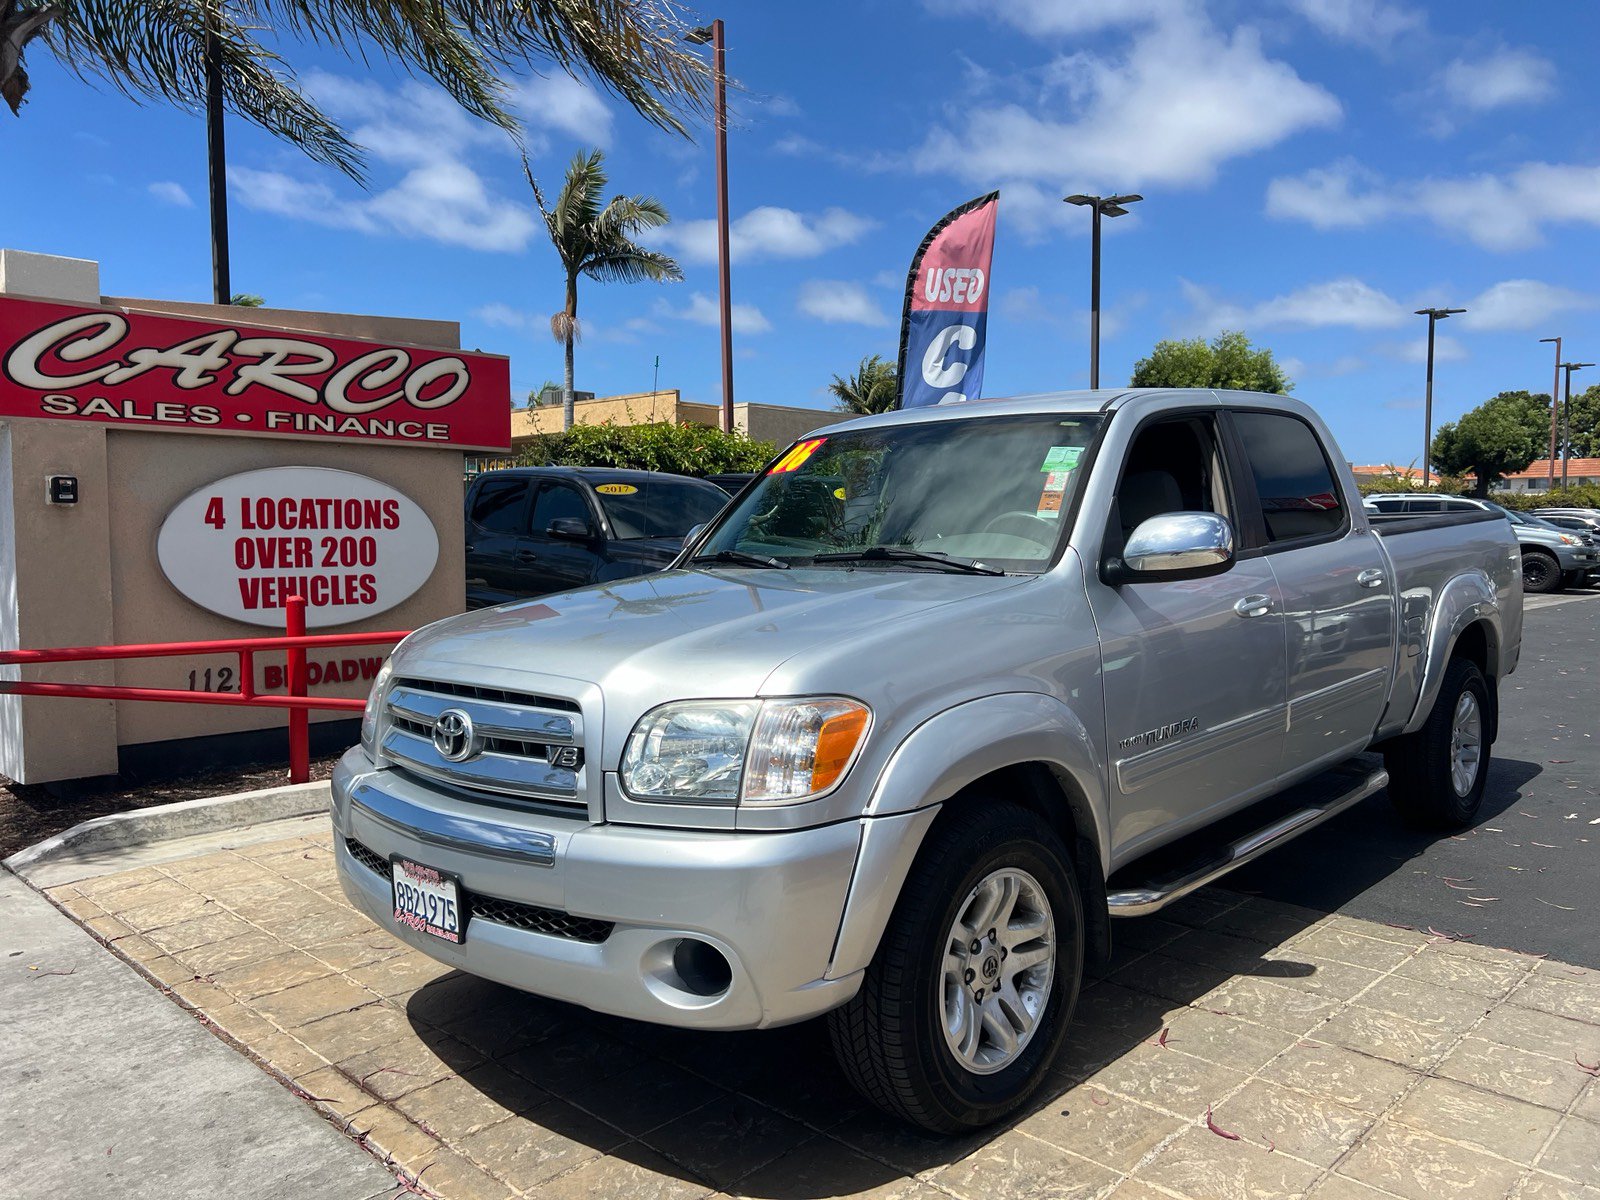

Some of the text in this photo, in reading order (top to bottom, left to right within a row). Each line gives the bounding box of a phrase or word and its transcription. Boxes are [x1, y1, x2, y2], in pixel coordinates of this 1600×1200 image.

[925, 268, 984, 304] USED
[4, 312, 470, 414] CARCO
[922, 325, 977, 404] C
[42, 394, 451, 441] SALES FINANCE
[205, 497, 400, 530] 4 LOCATIONS
[235, 536, 377, 570] OVER 200
[238, 574, 377, 610] VEHICLES
[188, 656, 389, 693] 112 BOADW
[1146, 716, 1199, 745] TUNDRA
[546, 745, 579, 767] V8
[396, 881, 457, 931] 8B21975
